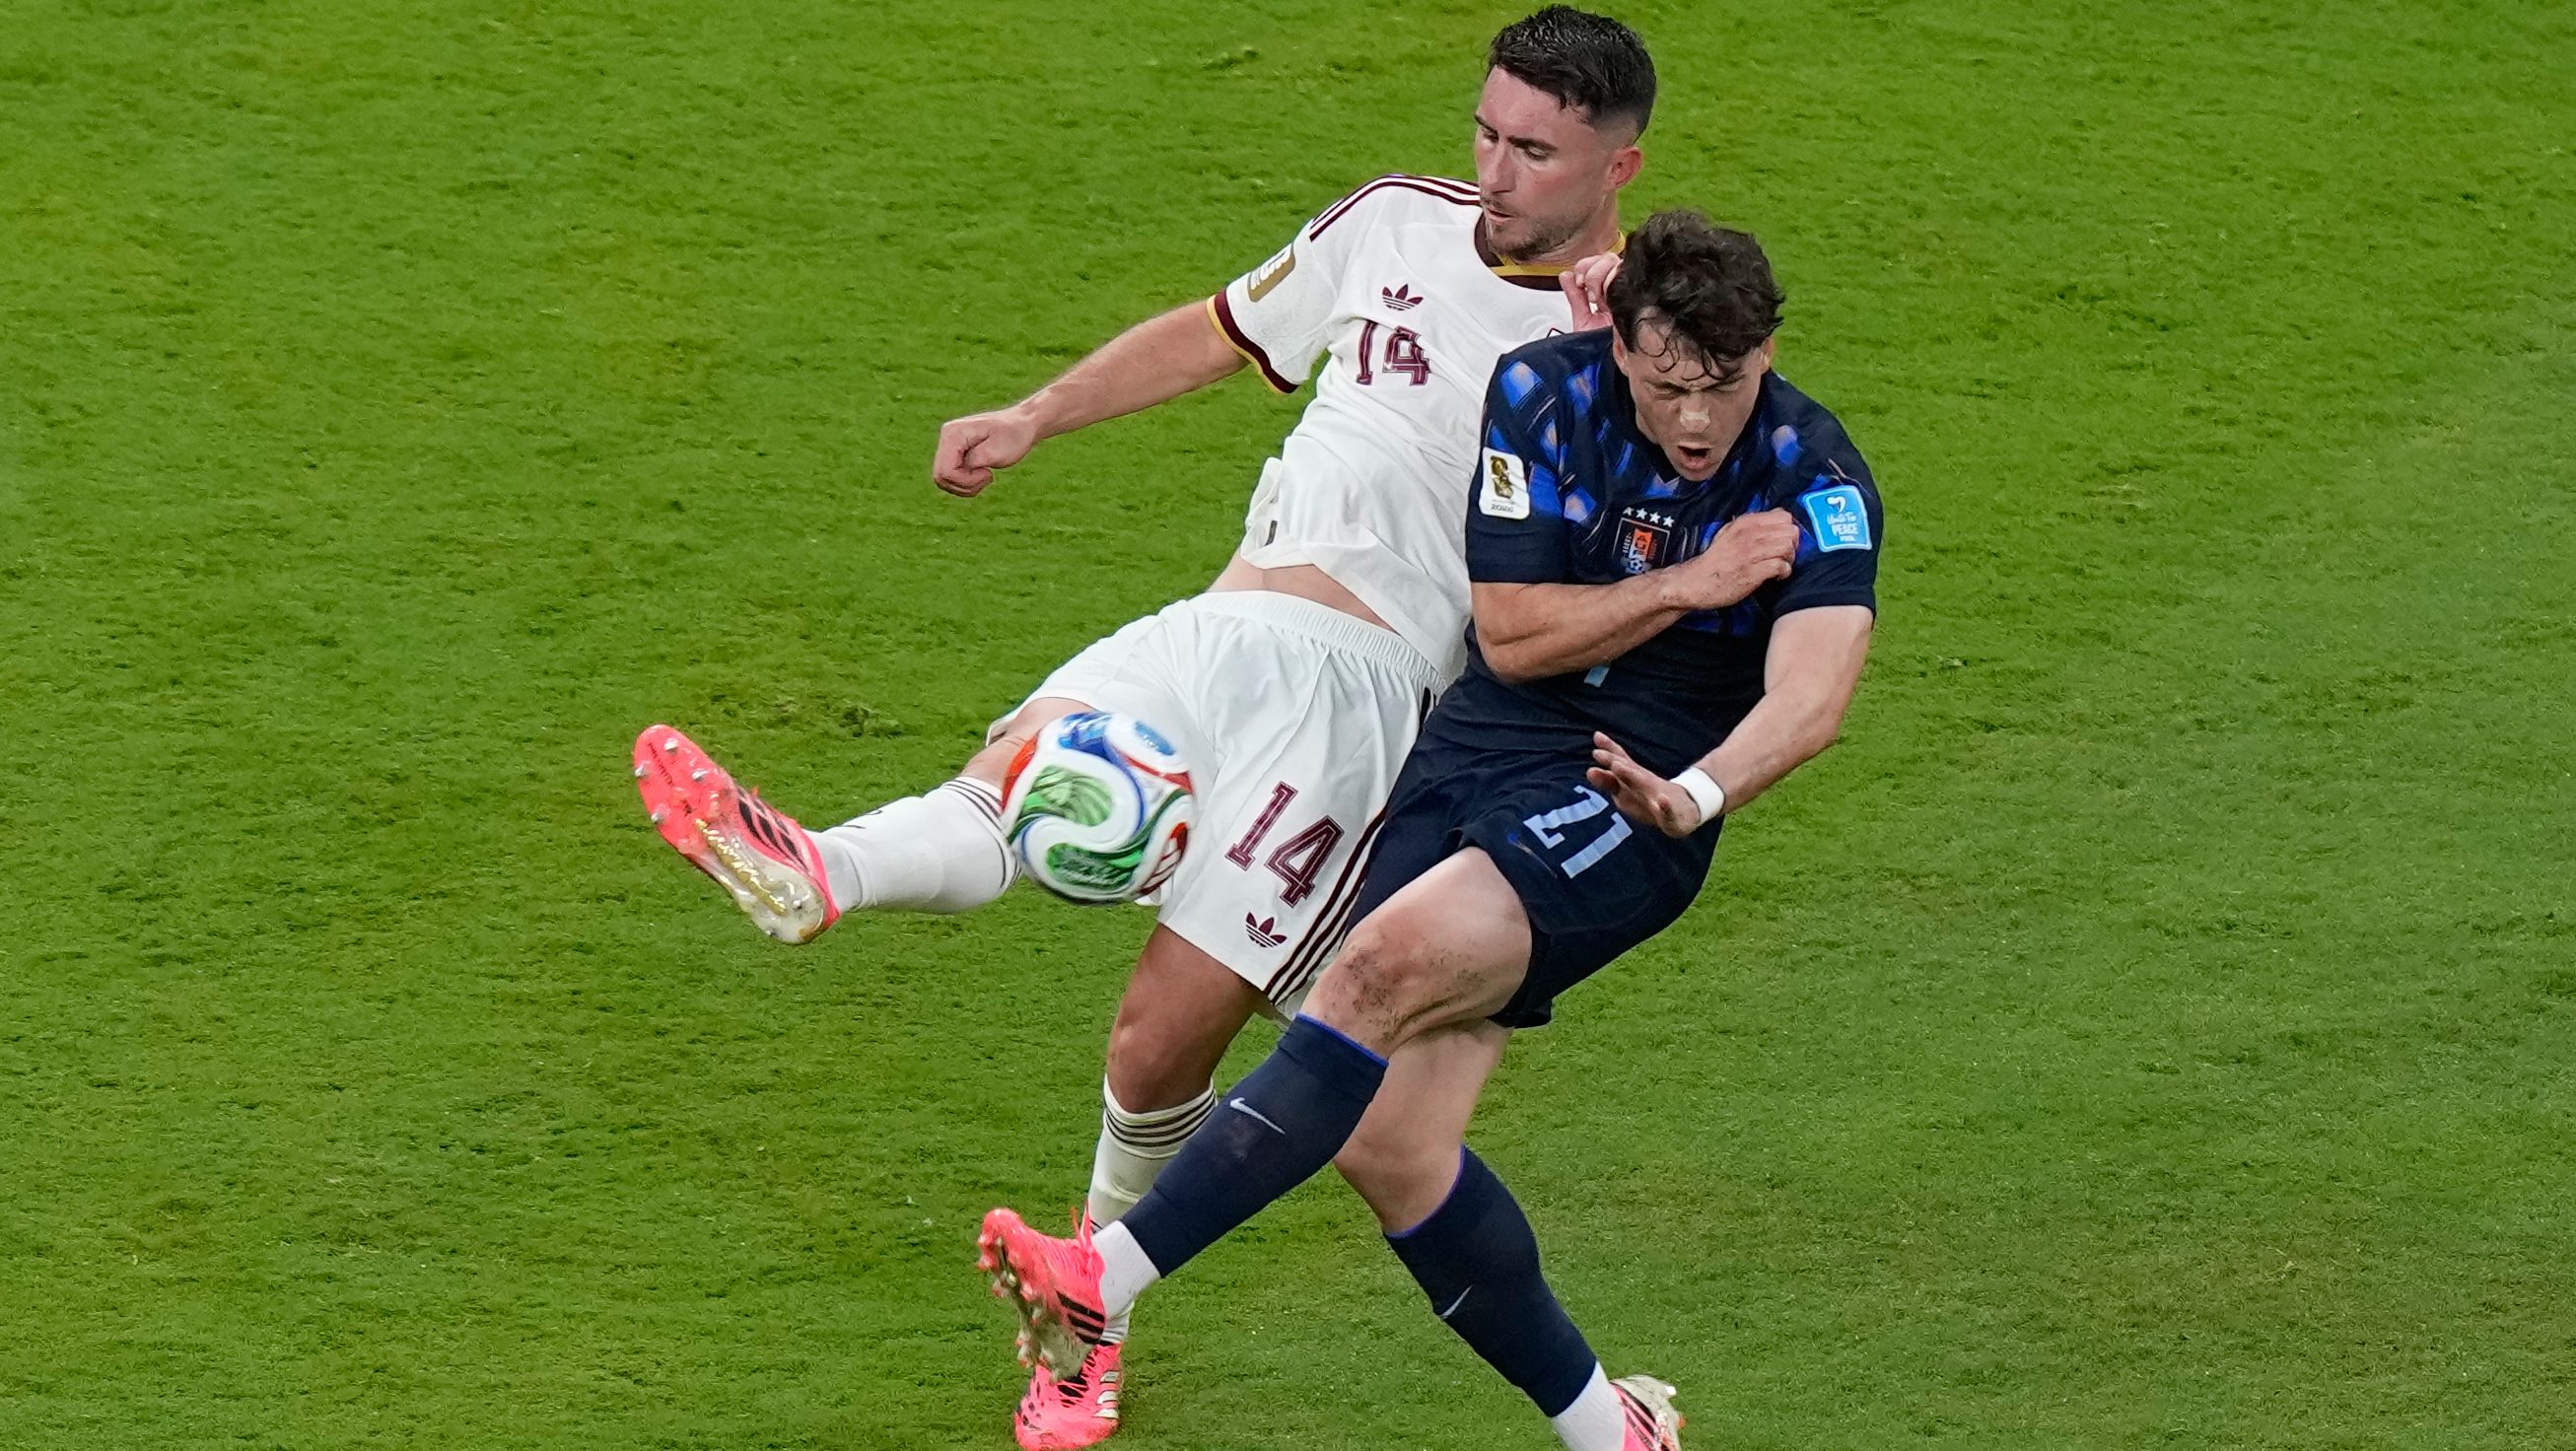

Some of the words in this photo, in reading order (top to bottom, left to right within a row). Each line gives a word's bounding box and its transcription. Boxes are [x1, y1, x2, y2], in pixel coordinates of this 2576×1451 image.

[1356, 320, 1430, 385] 14
[1224, 781, 1345, 908] 14
[1523, 785, 1633, 879] 21
